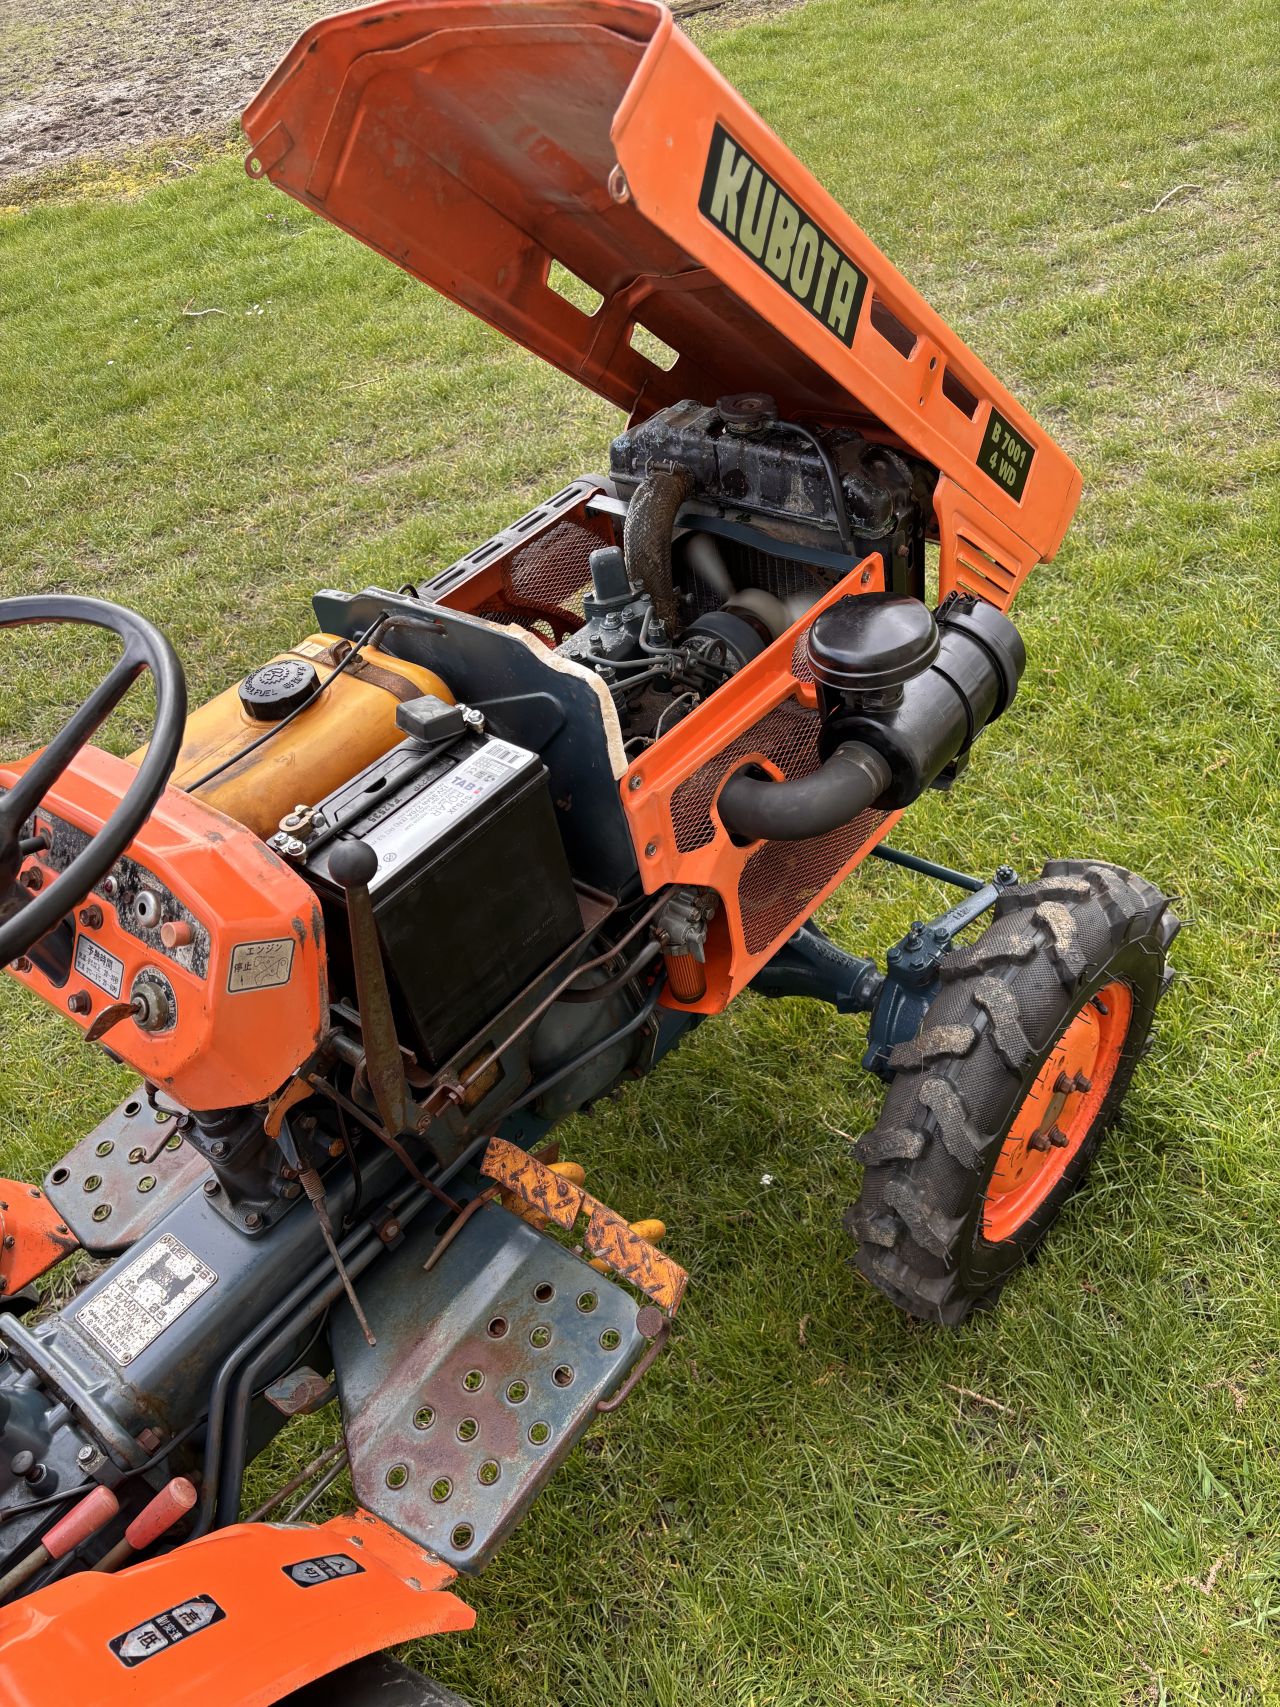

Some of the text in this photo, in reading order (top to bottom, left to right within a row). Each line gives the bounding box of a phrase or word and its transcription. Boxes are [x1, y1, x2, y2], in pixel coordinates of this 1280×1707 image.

[710, 138, 858, 337] KUBOTA
[992, 421, 1026, 468] B 7001
[990, 451, 1016, 486] 4 WD
[451, 776, 476, 791] TAB
[431, 791, 465, 817] POLAR
[246, 944, 282, 956] エンジン
[234, 962, 251, 973] 停止
[304, 1566, 320, 1578] 切
[330, 1561, 345, 1570] 入
[179, 1608, 200, 1626] 高
[137, 1630, 161, 1650] 低
